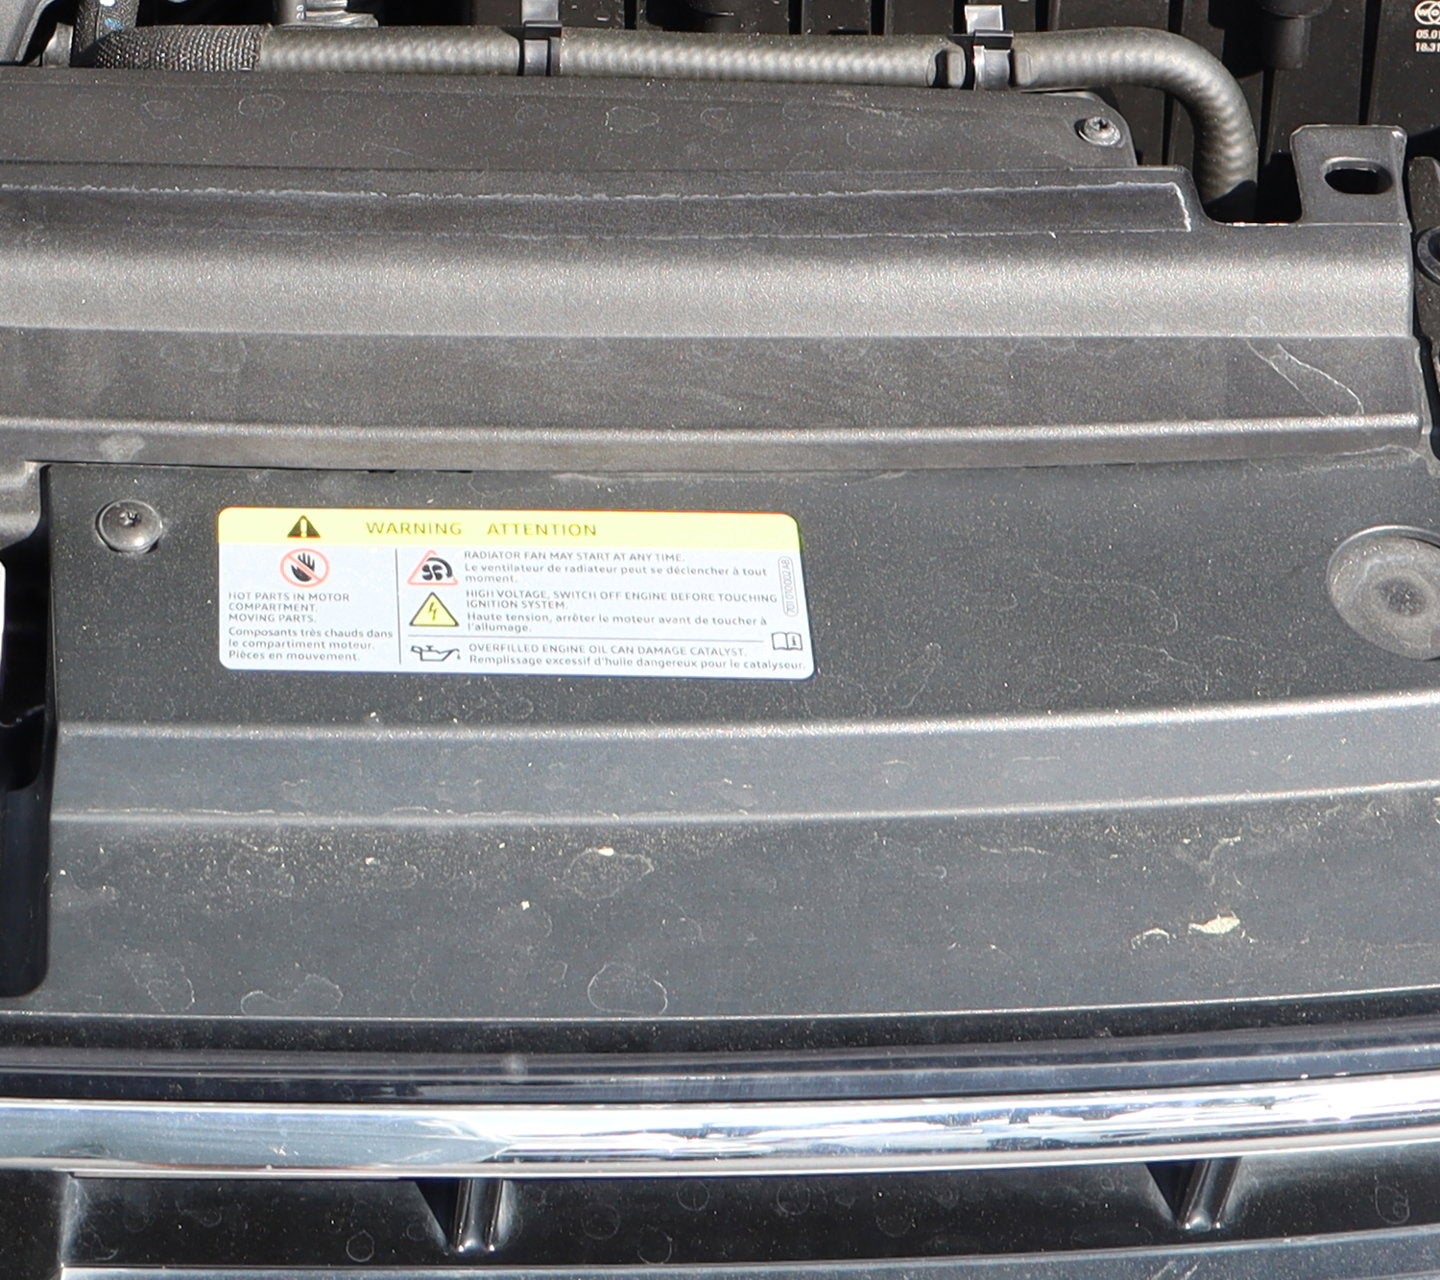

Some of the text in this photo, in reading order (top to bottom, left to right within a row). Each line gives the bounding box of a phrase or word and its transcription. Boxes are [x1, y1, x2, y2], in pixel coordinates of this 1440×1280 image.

[366, 522, 597, 536] WARNING ATTENTION
[464, 551, 520, 559] RADIATOR
[524, 551, 546, 560] FAN
[549, 552, 572, 560] MAY
[576, 552, 610, 561] START
[613, 553, 626, 561] AT
[629, 553, 653, 561] ANY
[464, 563, 478, 572] Le
[481, 563, 544, 572] ventilateur
[547, 564, 561, 573] de
[565, 564, 617, 573] radiateur
[621, 566, 646, 576] peut
[742, 568, 767, 576] tout
[229, 592, 350, 602] HOT PARTS IN MOTOR
[466, 590, 777, 603] HIGH SWITCH OFF ENGINE BEFORE TOUCHING
[466, 600, 518, 608] IGNITION
[229, 613, 275, 623] MOVING
[467, 613, 502, 621] Haute
[556, 613, 595, 622] arrêter
[613, 615, 654, 624] moteur
[658, 617, 691, 625] avant
[695, 616, 709, 625] de
[712, 616, 756, 626] toucher
[228, 627, 394, 639] Composants très chauds dans
[242, 639, 326, 651] compartiment
[469, 643, 539, 653] OVERFILLED
[542, 644, 585, 654] ENGINE
[589, 645, 607, 654] OIL
[611, 646, 634, 654] CAN
[637, 646, 686, 655] DAMAGE
[229, 650, 266, 660] Pièces
[269, 652, 282, 661] en
[470, 655, 542, 666] Remplissage
[545, 655, 590, 665] excessif
[637, 658, 697, 669] dangereux
[701, 660, 726, 669] pour
